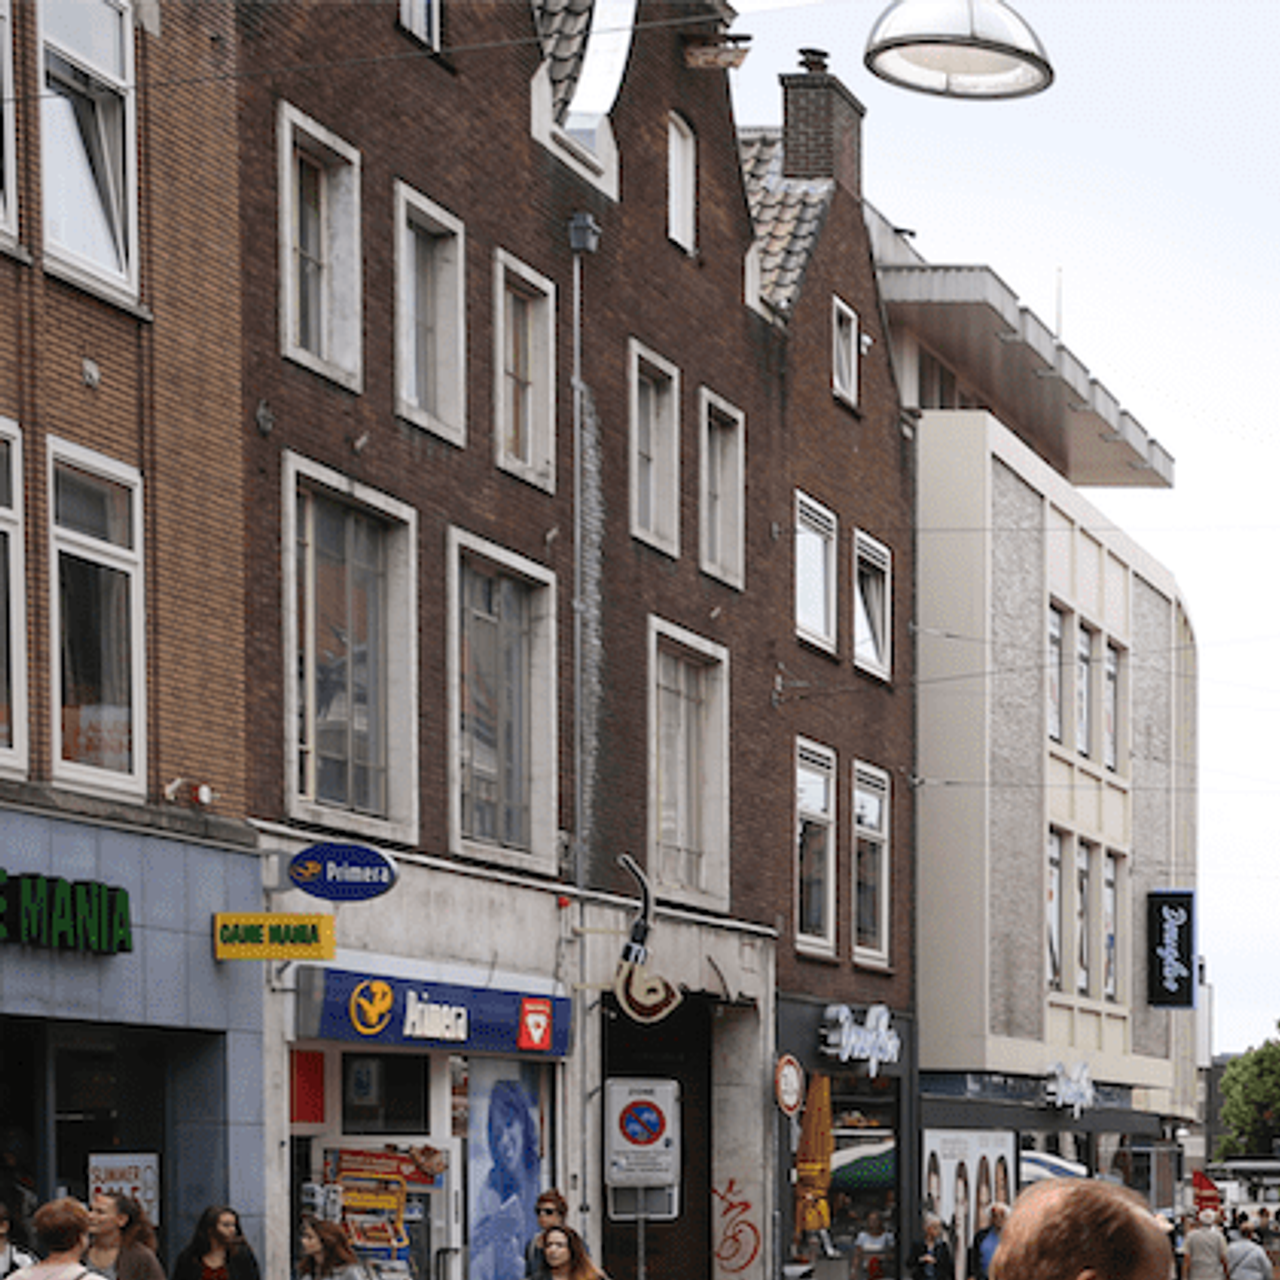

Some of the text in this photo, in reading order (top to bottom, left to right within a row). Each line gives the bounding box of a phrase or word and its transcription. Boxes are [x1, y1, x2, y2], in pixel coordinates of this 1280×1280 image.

[326, 858, 391, 885] Primera
[20, 873, 133, 953] MANIA
[1156, 904, 1190, 993] Douglas
